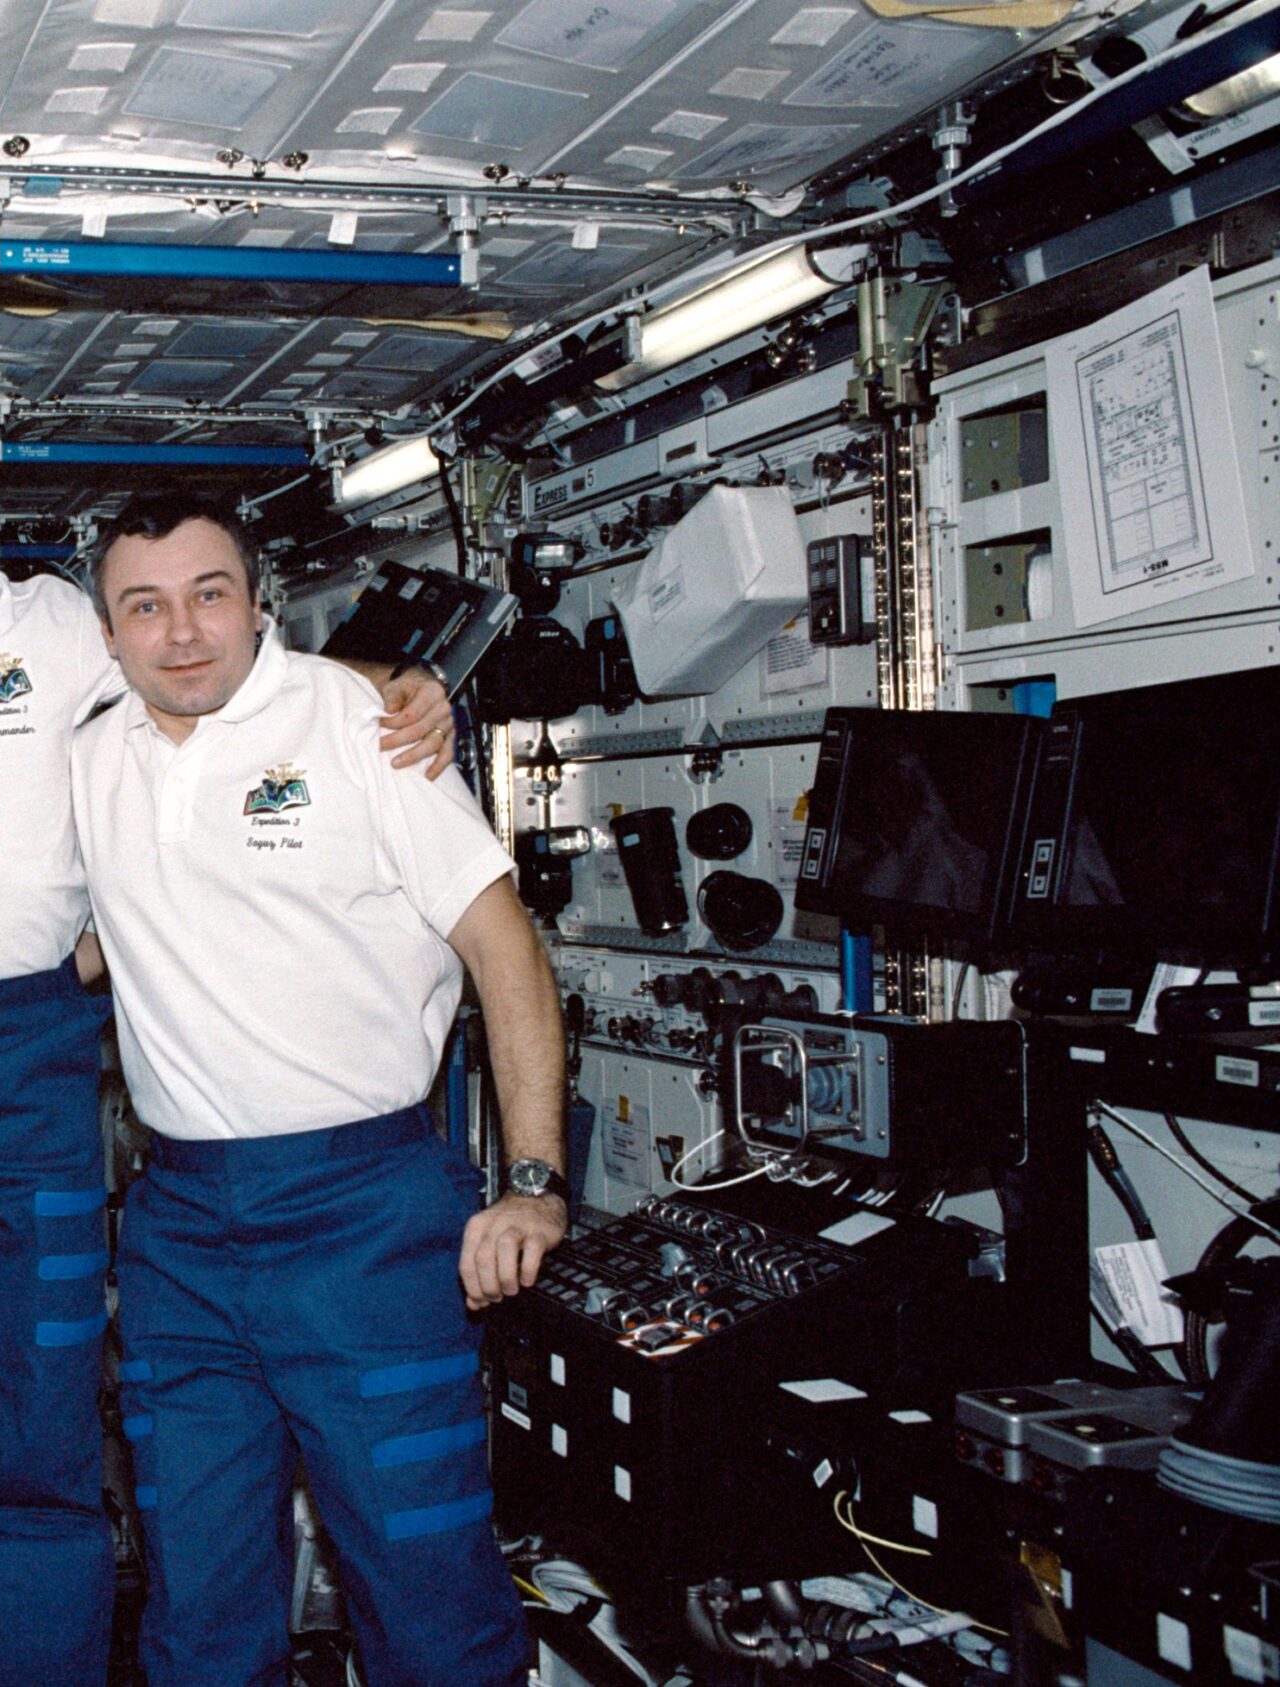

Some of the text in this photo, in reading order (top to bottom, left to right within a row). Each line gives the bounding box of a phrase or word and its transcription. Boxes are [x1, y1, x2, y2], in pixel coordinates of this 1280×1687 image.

[587, 468, 594, 487] 5
[252, 817, 290, 828] Expedition
[280, 838, 303, 848] Pilot
